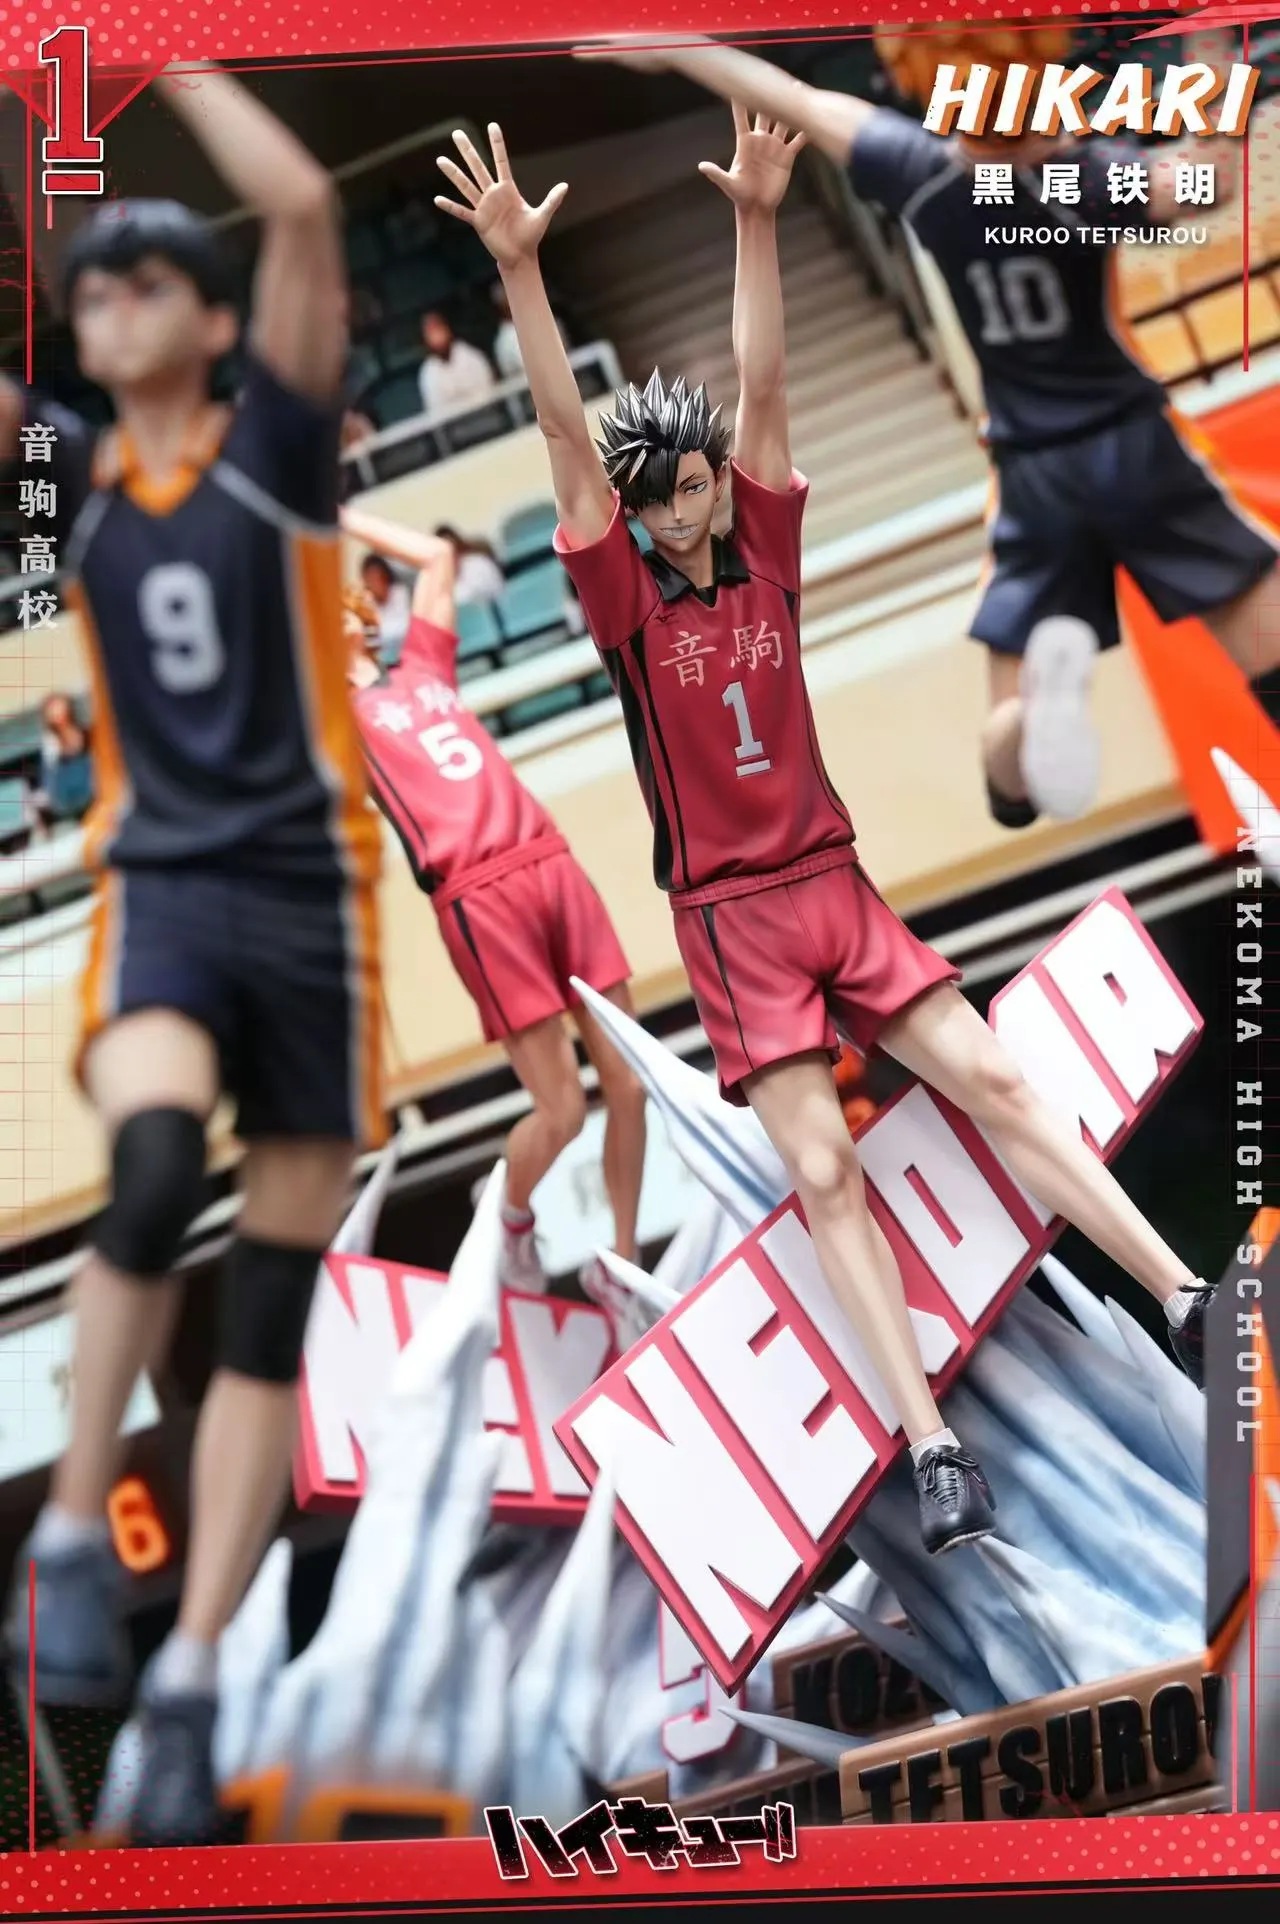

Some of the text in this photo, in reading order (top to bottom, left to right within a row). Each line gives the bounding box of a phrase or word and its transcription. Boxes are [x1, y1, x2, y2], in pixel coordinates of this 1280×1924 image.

[965, 257, 1071, 344] 10
[136, 562, 227, 694] 9
[659, 620, 784, 687] 音駒
[418, 721, 484, 781] 5
[721, 681, 765, 760] 1
[107, 1474, 169, 1573] 6
